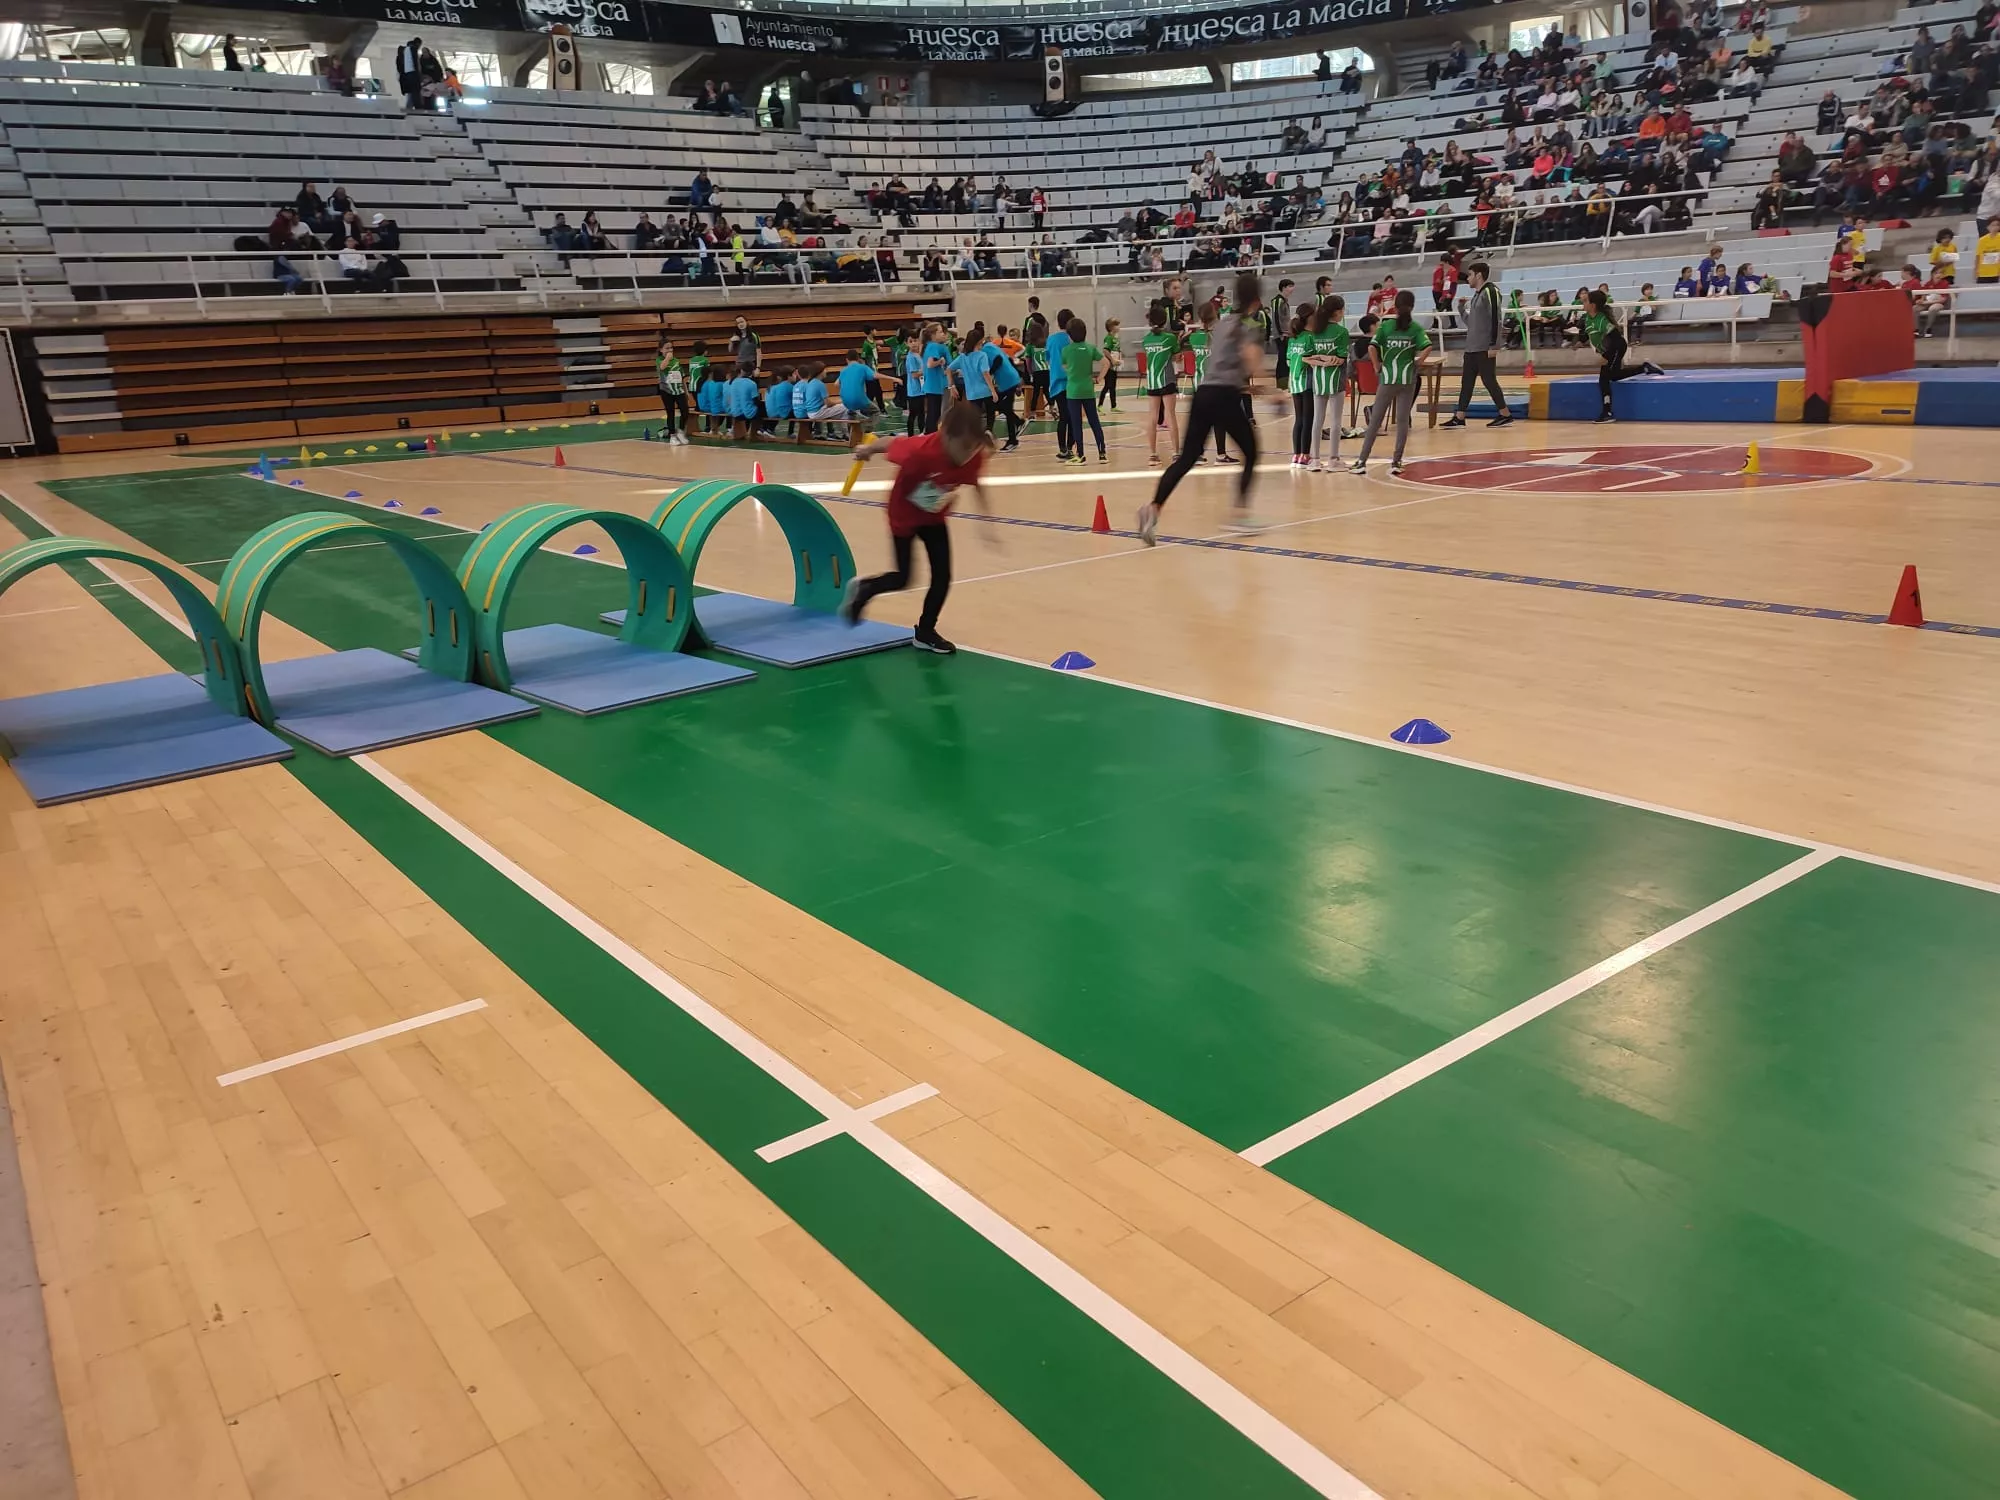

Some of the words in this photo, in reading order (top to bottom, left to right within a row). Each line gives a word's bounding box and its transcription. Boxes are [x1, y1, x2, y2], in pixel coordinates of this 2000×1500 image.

[745, 17, 834, 37] Ayuntamiento
[748, 34, 765, 48] de
[766, 35, 816, 52] Huesca
